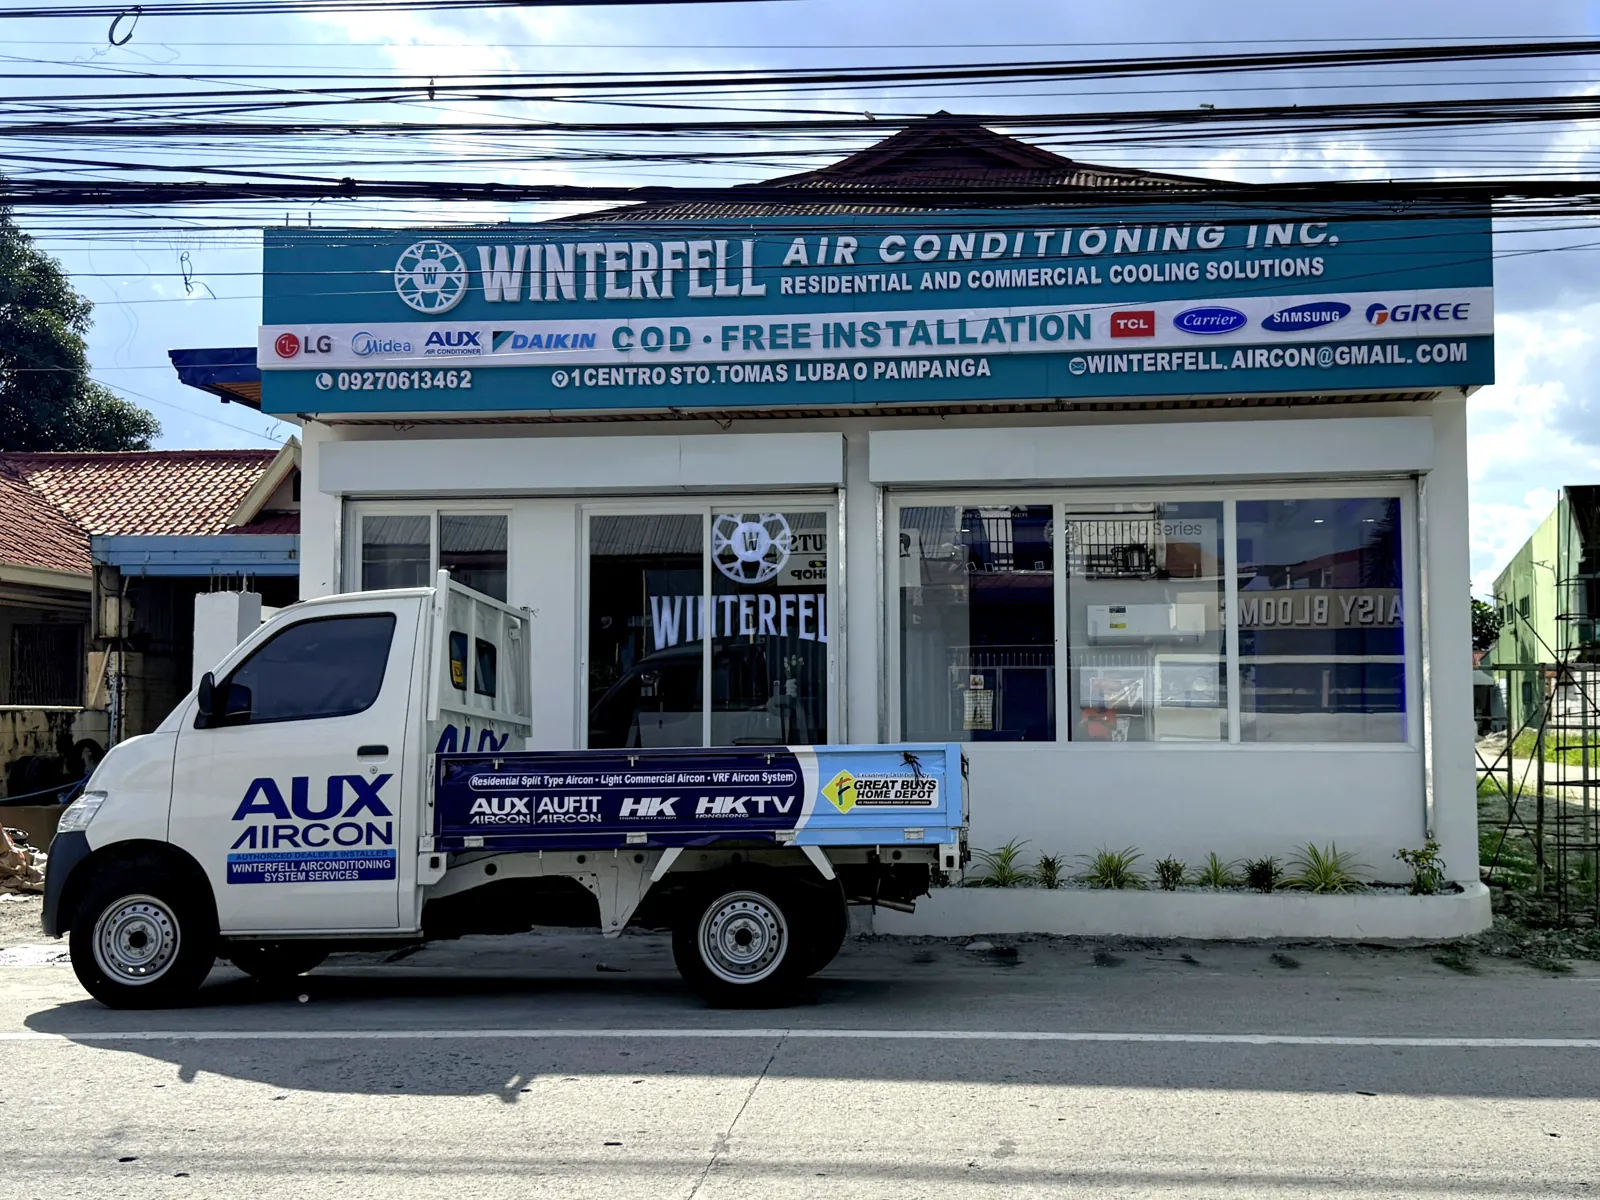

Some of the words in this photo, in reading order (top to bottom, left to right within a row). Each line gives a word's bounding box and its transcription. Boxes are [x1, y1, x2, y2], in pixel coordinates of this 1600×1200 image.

[782, 235, 859, 266] AIR
[878, 223, 1226, 264] CONDITIONING
[1246, 222, 1340, 248] INC.
[421, 266, 438, 285] W
[477, 239, 767, 302] WINTERFELL
[780, 273, 913, 295] RESIDENTIAL
[920, 271, 962, 291] AND
[967, 266, 1102, 289] COMMERCIAL
[1109, 262, 1200, 284] COOLING
[1205, 257, 1325, 281] SOLUTIONS
[1183, 313, 1238, 327] Carrier
[1273, 310, 1340, 323] SAMSUNG
[1390, 303, 1471, 322] GREE
[1116, 319, 1149, 329] TCL
[424, 331, 481, 347] AUX
[612, 326, 691, 352] COD
[721, 323, 812, 352] FREE
[822, 313, 1091, 349] INSTALLATION
[304, 335, 332, 354] LG
[360, 339, 412, 355] Midea
[511, 333, 597, 349] DAIKIN
[795, 361, 868, 382] LUBAO
[873, 358, 991, 380] PAMPANGA
[337, 370, 473, 391] 09270613462
[1152, 521, 1203, 536] Series
[471, 775, 519, 786] Residential
[521, 774, 541, 788] Split
[543, 775, 564, 787] Type
[565, 774, 594, 785] Aircon
[600, 774, 622, 786] Light
[624, 773, 675, 784] Commercial
[677, 773, 705, 783] Aircon
[712, 773, 730, 782] VRF
[732, 772, 760, 782] Aircon
[762, 772, 794, 784] System
[854, 780, 898, 790] GREAT
[901, 780, 937, 790] BUYS
[231, 773, 395, 821] AUX
[856, 790, 891, 799] HOME
[894, 790, 934, 799] DEPOT
[469, 797, 530, 815] AUX
[537, 796, 602, 814] AUFIT
[618, 797, 681, 816] HK
[470, 815, 531, 824] AIRCON
[537, 813, 602, 823] AIRCON
[230, 821, 393, 850] AIRCON
[236, 852, 293, 861] AUTHORIZED
[294, 851, 330, 859] DEALER
[340, 849, 389, 858] INSTALLER
[232, 862, 298, 873] WINTERFELL
[300, 859, 391, 871] AIRCONDITIONING
[264, 871, 306, 882] SYSTEM
[308, 870, 359, 880] SERVICES
